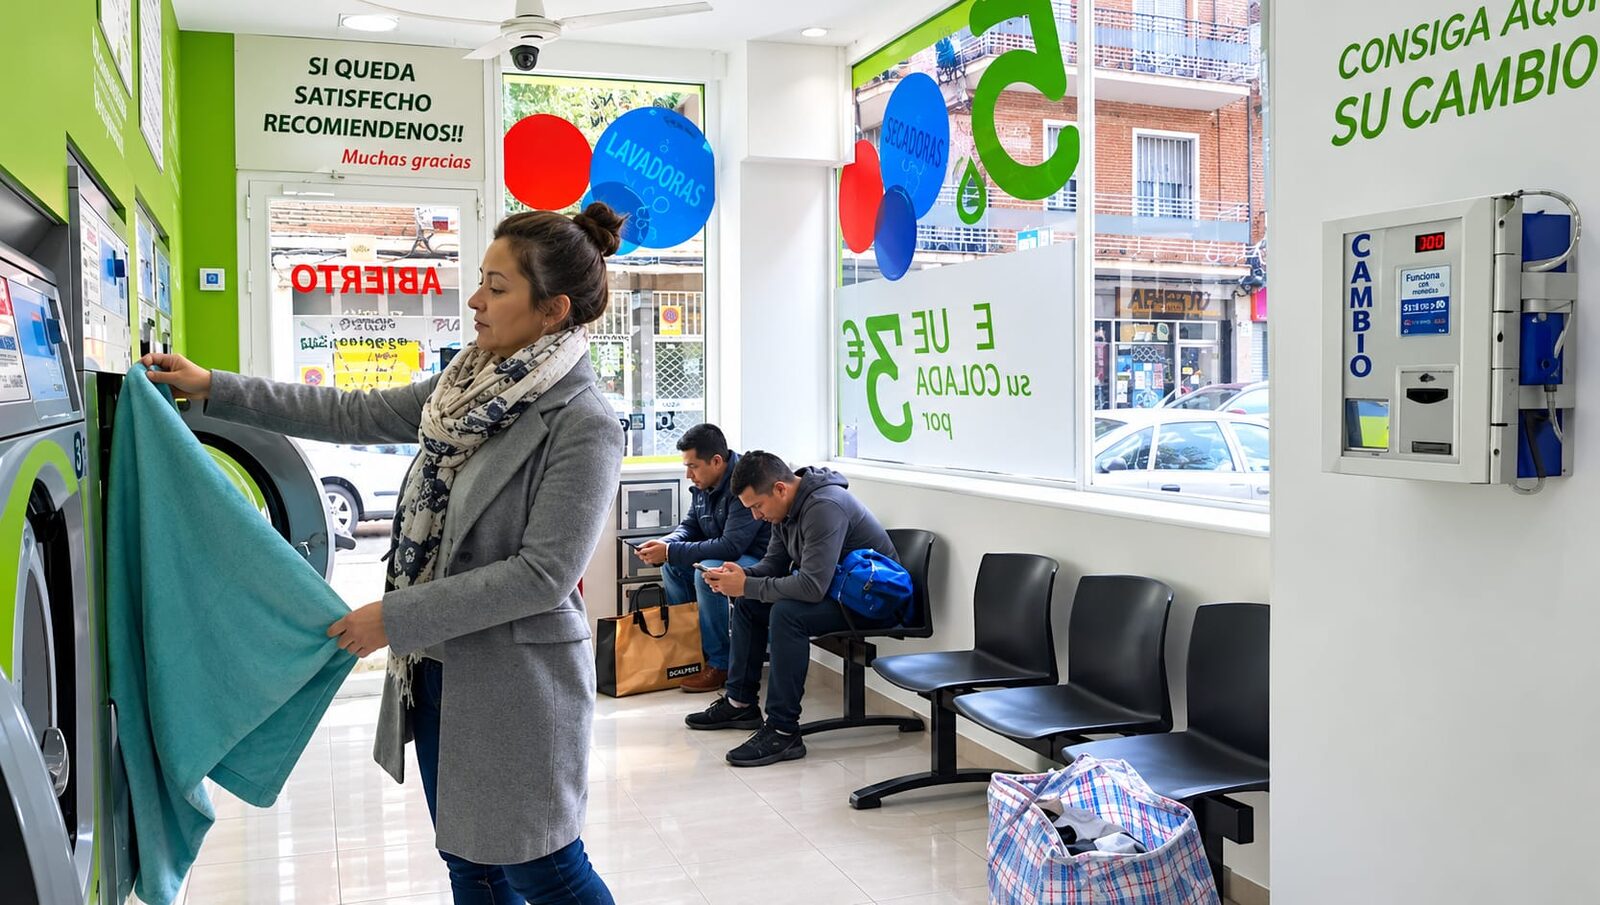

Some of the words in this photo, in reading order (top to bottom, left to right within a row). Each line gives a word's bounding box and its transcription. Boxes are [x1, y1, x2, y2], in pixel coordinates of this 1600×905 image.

[1338, 6, 1490, 80] CONSIGA
[1500, 0, 1597, 36] AQ
[308, 57, 328, 76] SI
[334, 58, 415, 82] QUEDA
[1331, 87, 1391, 146] SU
[1402, 34, 1599, 129] CAMBIO
[294, 85, 432, 112] SATISFECHO
[263, 113, 464, 143] RECOMIENDENOS!!
[884, 116, 945, 169] SECADORAS
[341, 148, 407, 166] Muchas
[411, 153, 471, 171] gracias
[605, 131, 706, 207] LAVADORAS
[1406, 272, 1440, 282] Funciona
[1350, 233, 1373, 377] CAMBIO
